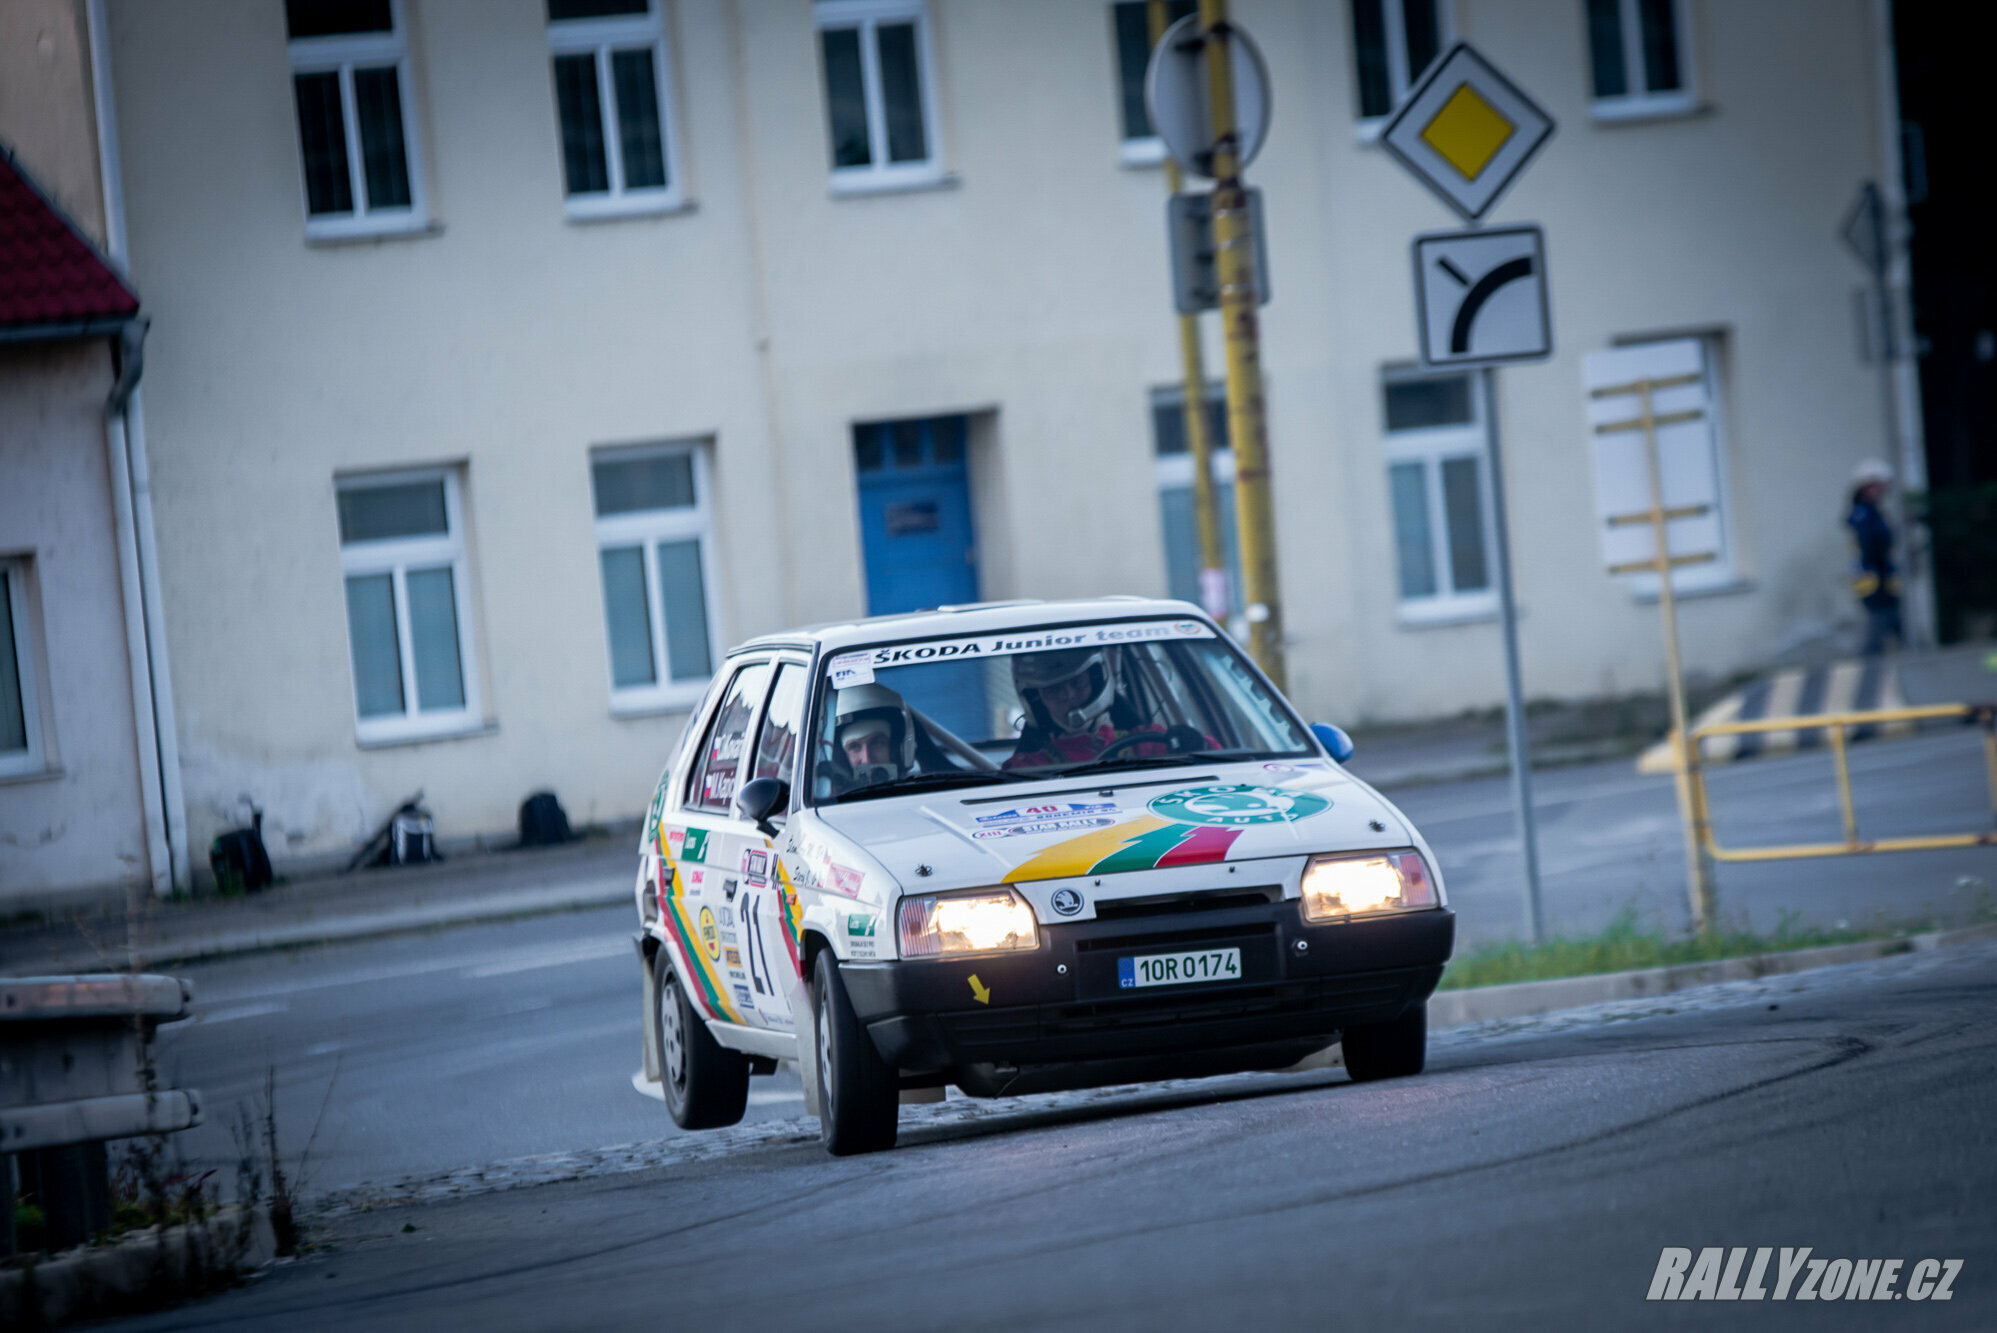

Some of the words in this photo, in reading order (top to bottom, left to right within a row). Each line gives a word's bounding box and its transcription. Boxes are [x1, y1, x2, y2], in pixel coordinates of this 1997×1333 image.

[873, 641, 981, 665] ŠKODA
[991, 631, 1087, 652] Junior
[1095, 625, 1171, 641] team
[1026, 805, 1058, 814] 40
[740, 892, 775, 997] 21
[1140, 958, 1179, 982] 10R
[1182, 952, 1238, 978] 0174
[1121, 978, 1134, 987] CZ
